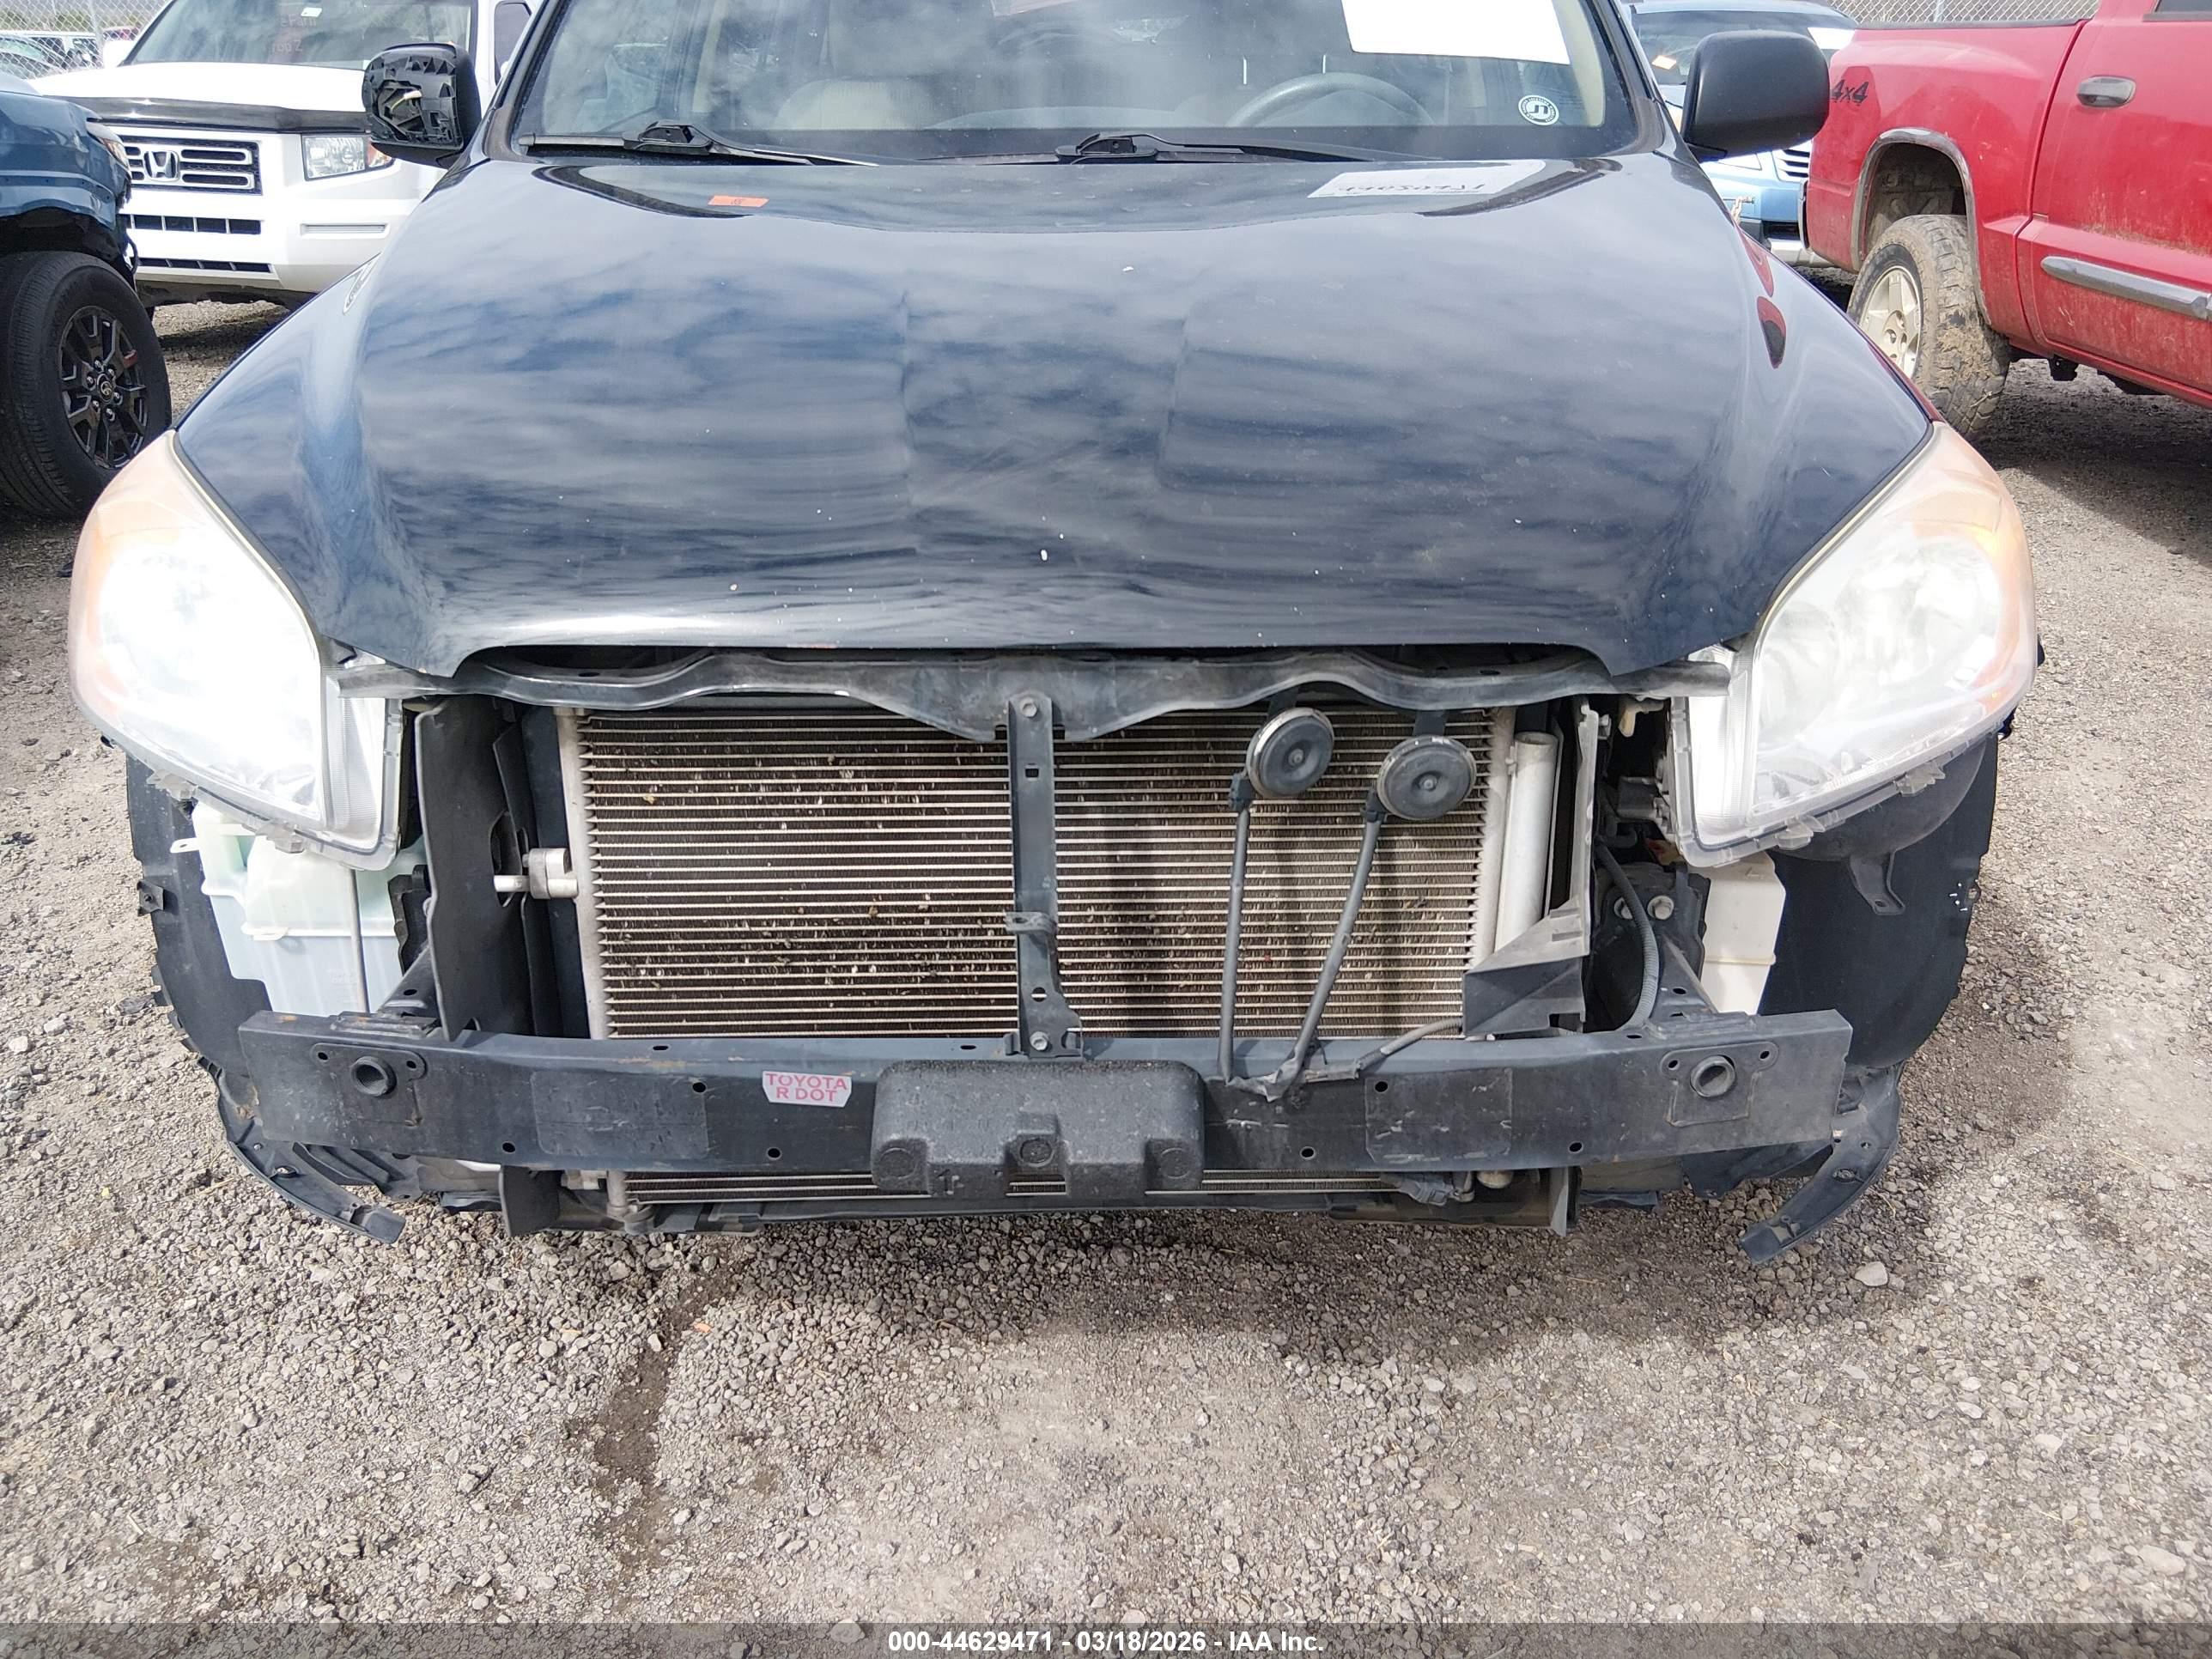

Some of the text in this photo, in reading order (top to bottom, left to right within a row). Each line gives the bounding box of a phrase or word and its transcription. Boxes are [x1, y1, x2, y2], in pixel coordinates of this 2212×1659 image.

[1831, 79, 1869, 106] 4x4
[765, 1073, 848, 1090] TOYOTA
[776, 1086, 838, 1102] R DOT
